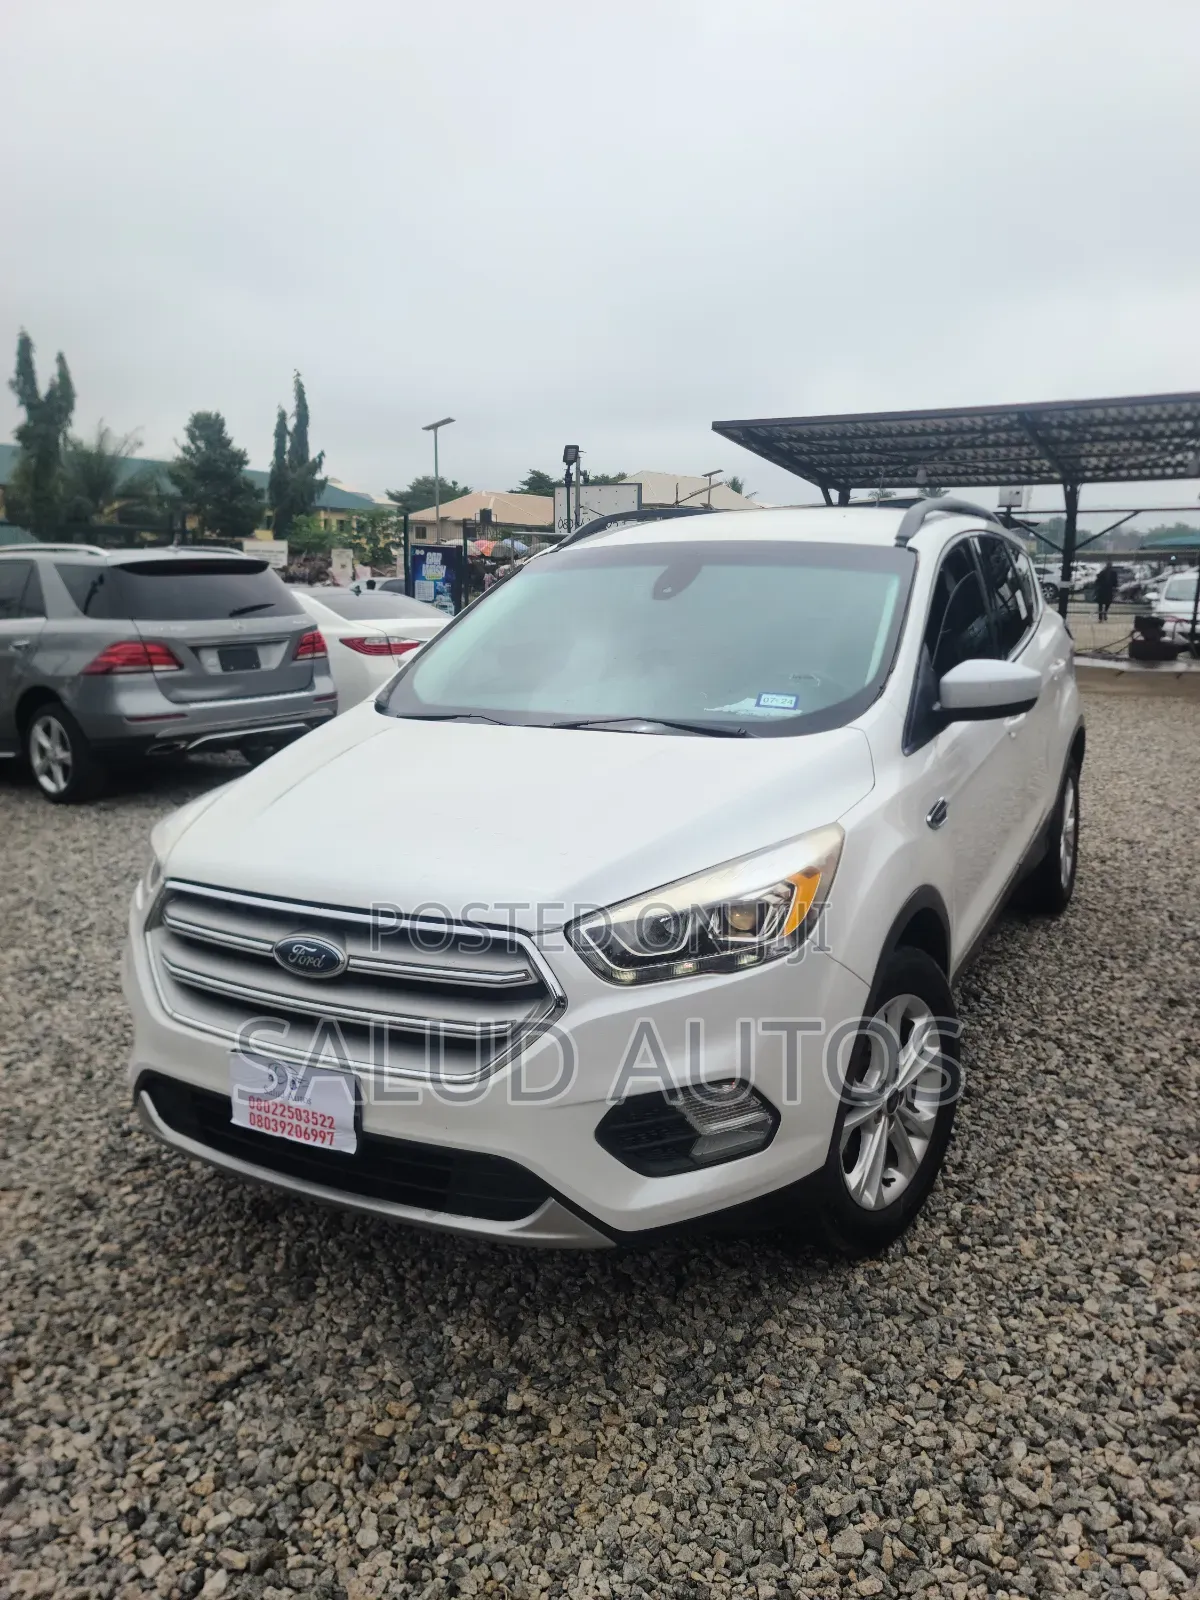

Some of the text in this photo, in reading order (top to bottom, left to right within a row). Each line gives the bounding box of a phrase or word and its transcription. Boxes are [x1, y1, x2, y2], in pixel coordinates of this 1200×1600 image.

[288, 944, 326, 968] Ford
[248, 1095, 336, 1130] 08022503522
[249, 1112, 335, 1146] 08039206997
